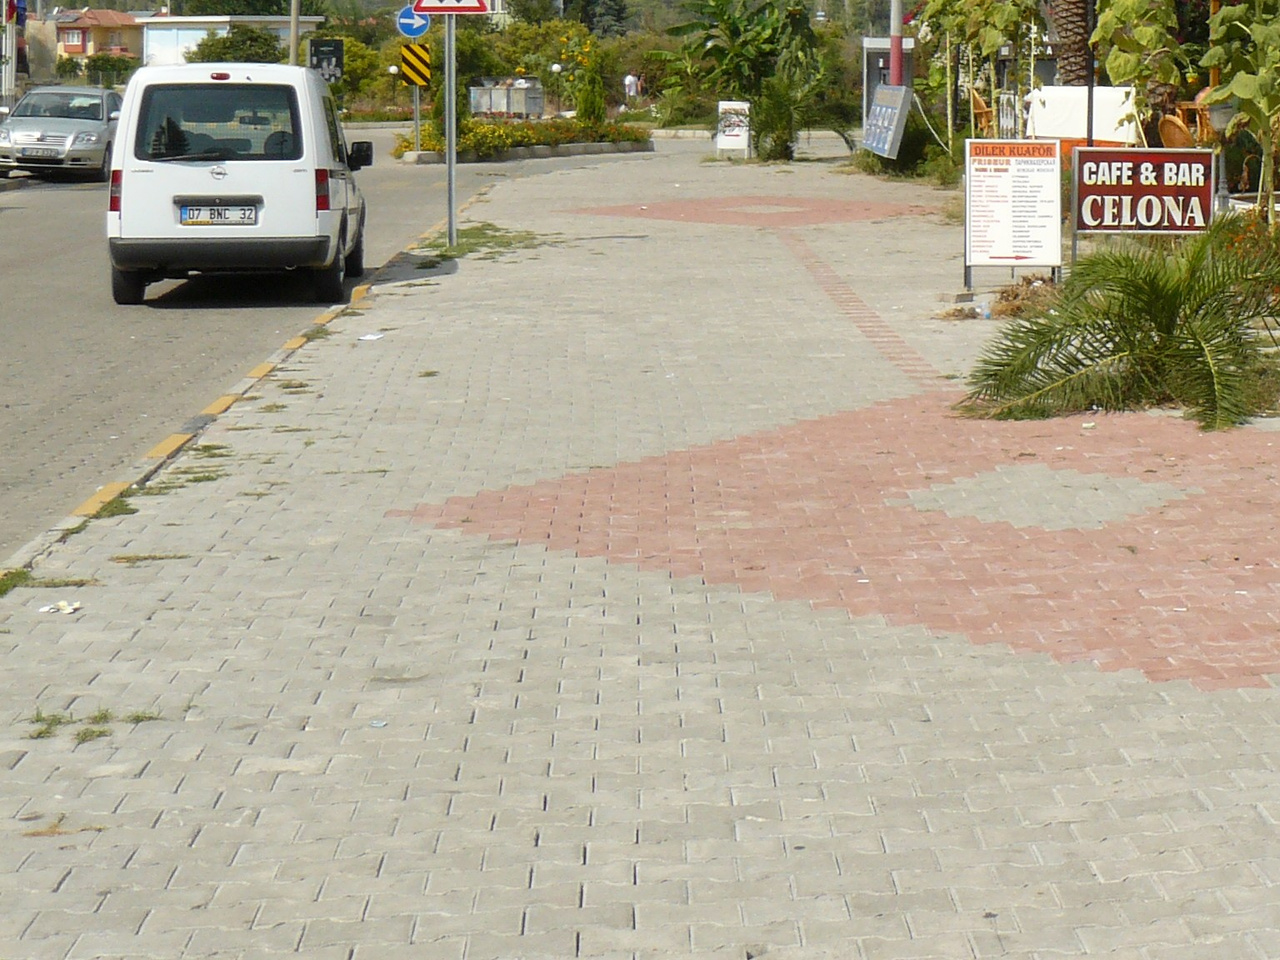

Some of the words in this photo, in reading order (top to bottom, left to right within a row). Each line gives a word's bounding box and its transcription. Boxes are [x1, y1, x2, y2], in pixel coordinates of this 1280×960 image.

[971, 158, 1011, 166] FRISEUR
[1083, 161, 1133, 185] CAFE
[1140, 162, 1158, 186] &
[1163, 162, 1205, 187] BAR
[188, 207, 201, 220] 07
[209, 207, 230, 220] BNC
[240, 207, 254, 220] 32
[1081, 194, 1206, 227] CELONA
